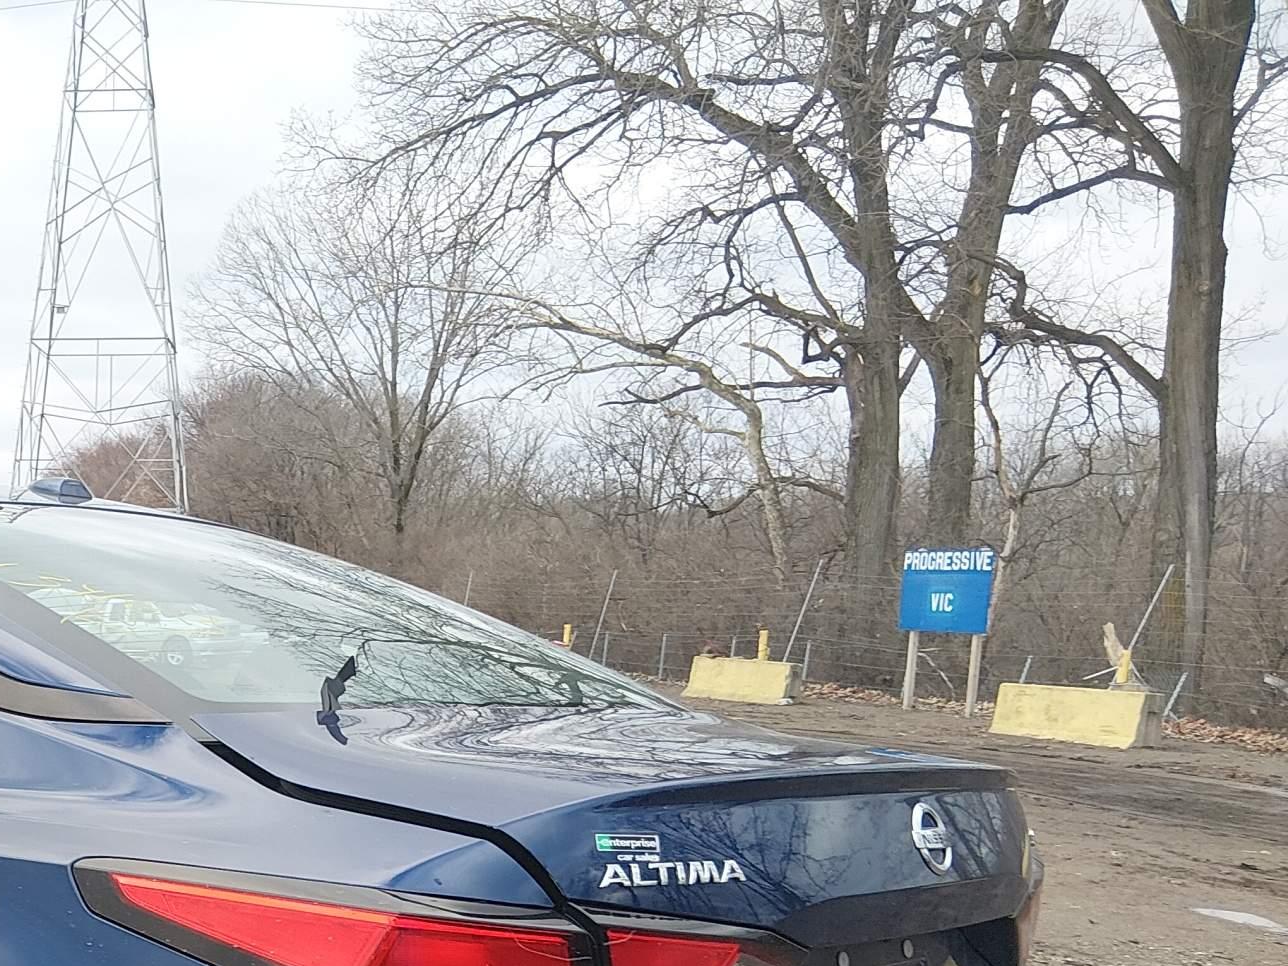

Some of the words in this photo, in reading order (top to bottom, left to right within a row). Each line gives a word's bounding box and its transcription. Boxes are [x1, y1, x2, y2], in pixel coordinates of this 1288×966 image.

[903, 551, 993, 571] PROGRESSIVE
[930, 593, 954, 612] VIC
[600, 837, 657, 849] enterprise
[599, 859, 747, 888] ALTIMA
